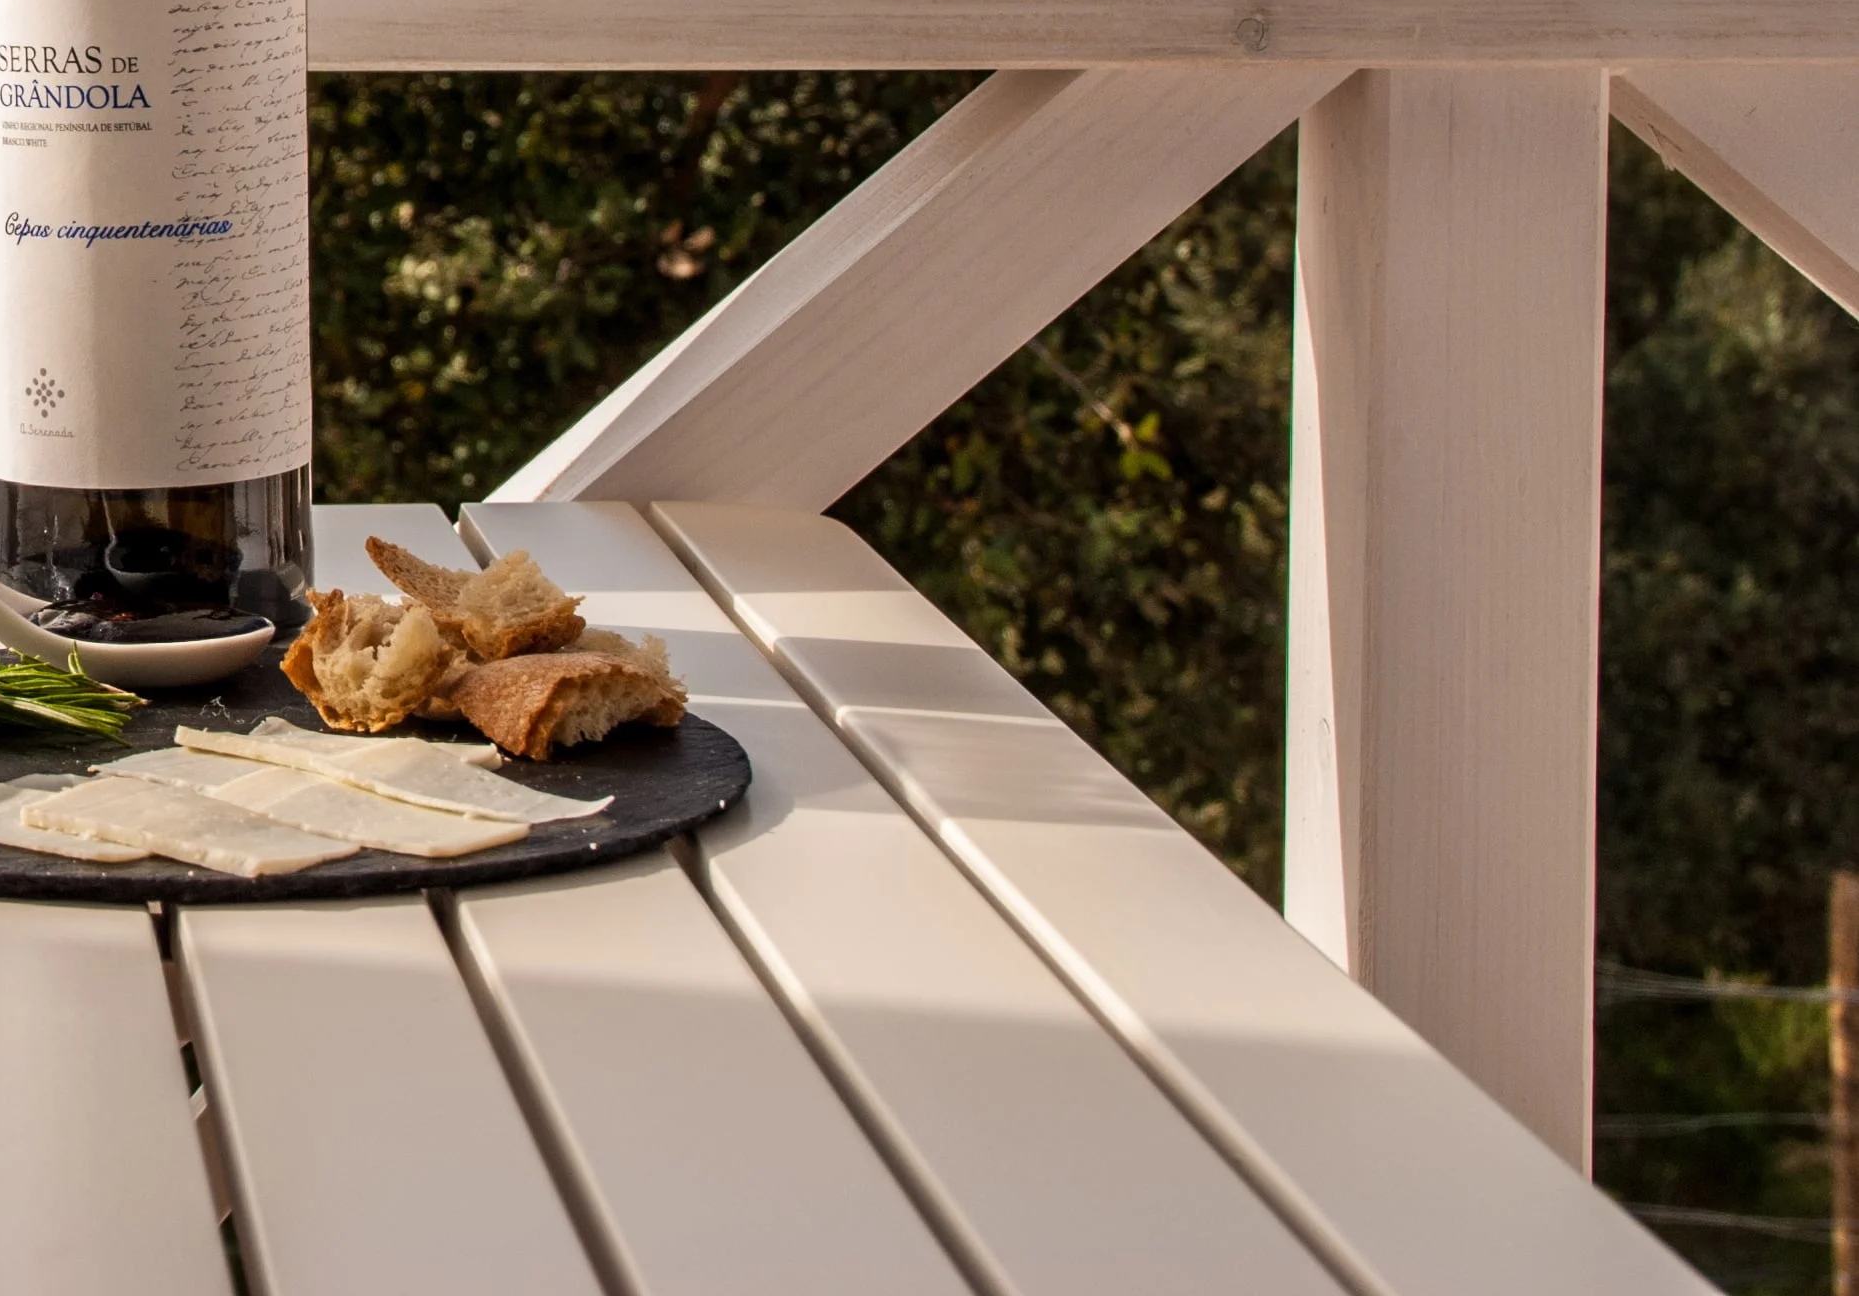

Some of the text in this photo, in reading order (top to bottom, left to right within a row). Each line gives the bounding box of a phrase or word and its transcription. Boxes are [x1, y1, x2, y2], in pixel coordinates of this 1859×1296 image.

[111, 57, 139, 74] DE
[0, 79, 152, 109] GRÂNDOLA
[100, 122, 112, 132] DE
[113, 121, 152, 132] SETÚBAL
[4, 211, 233, 248] Cepas cinquentenárias
